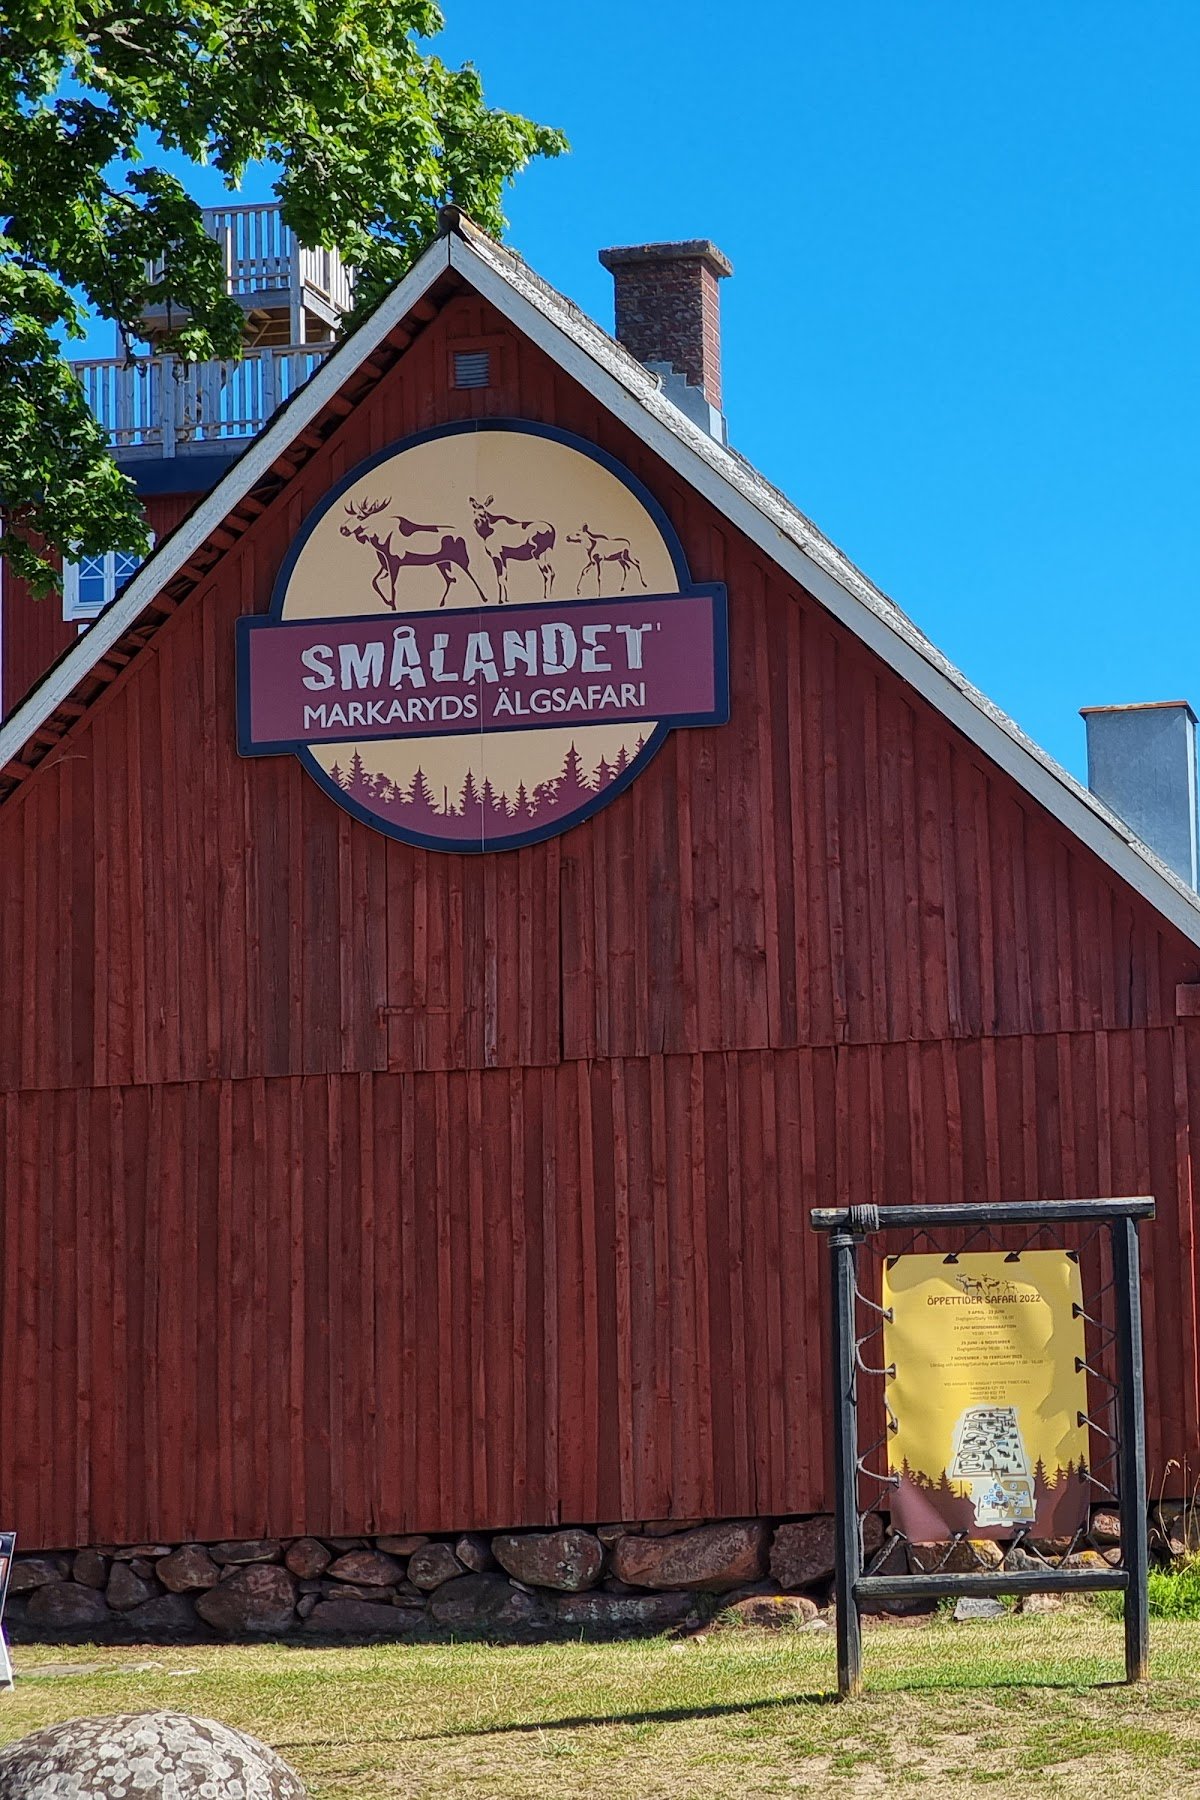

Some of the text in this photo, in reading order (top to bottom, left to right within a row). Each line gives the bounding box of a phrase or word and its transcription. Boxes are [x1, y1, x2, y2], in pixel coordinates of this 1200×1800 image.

[303, 683, 646, 729] MARKARYDS ÄLGSAFARI
[927, 1293, 1042, 1306] ÖPPETTIDER SAFARI 2022
